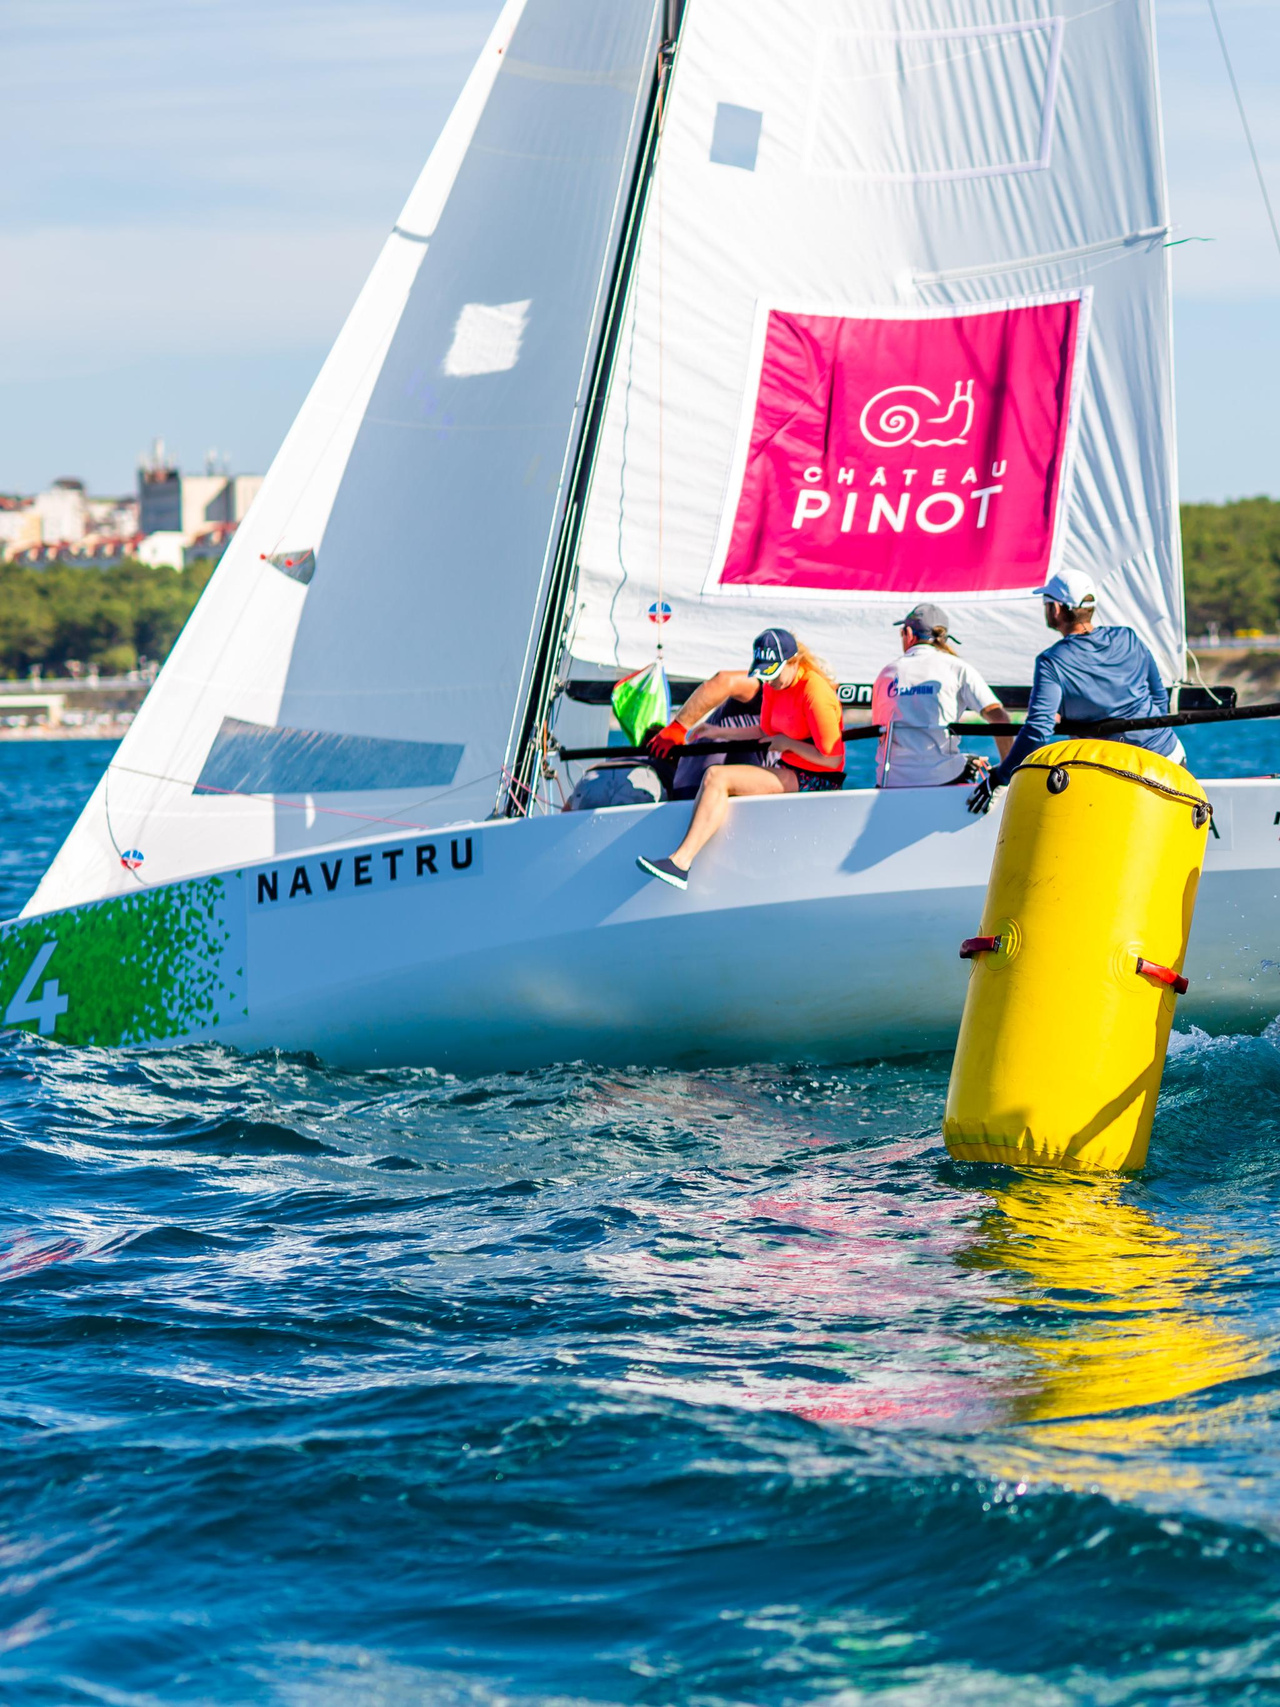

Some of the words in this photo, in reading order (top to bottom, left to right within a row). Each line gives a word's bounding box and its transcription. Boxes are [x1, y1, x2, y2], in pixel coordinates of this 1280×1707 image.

[803, 460, 1007, 486] CHÂTEAU
[791, 485, 1003, 533] PINOT
[256, 837, 474, 904] NAVETRU
[4, 940, 69, 1036] 4
